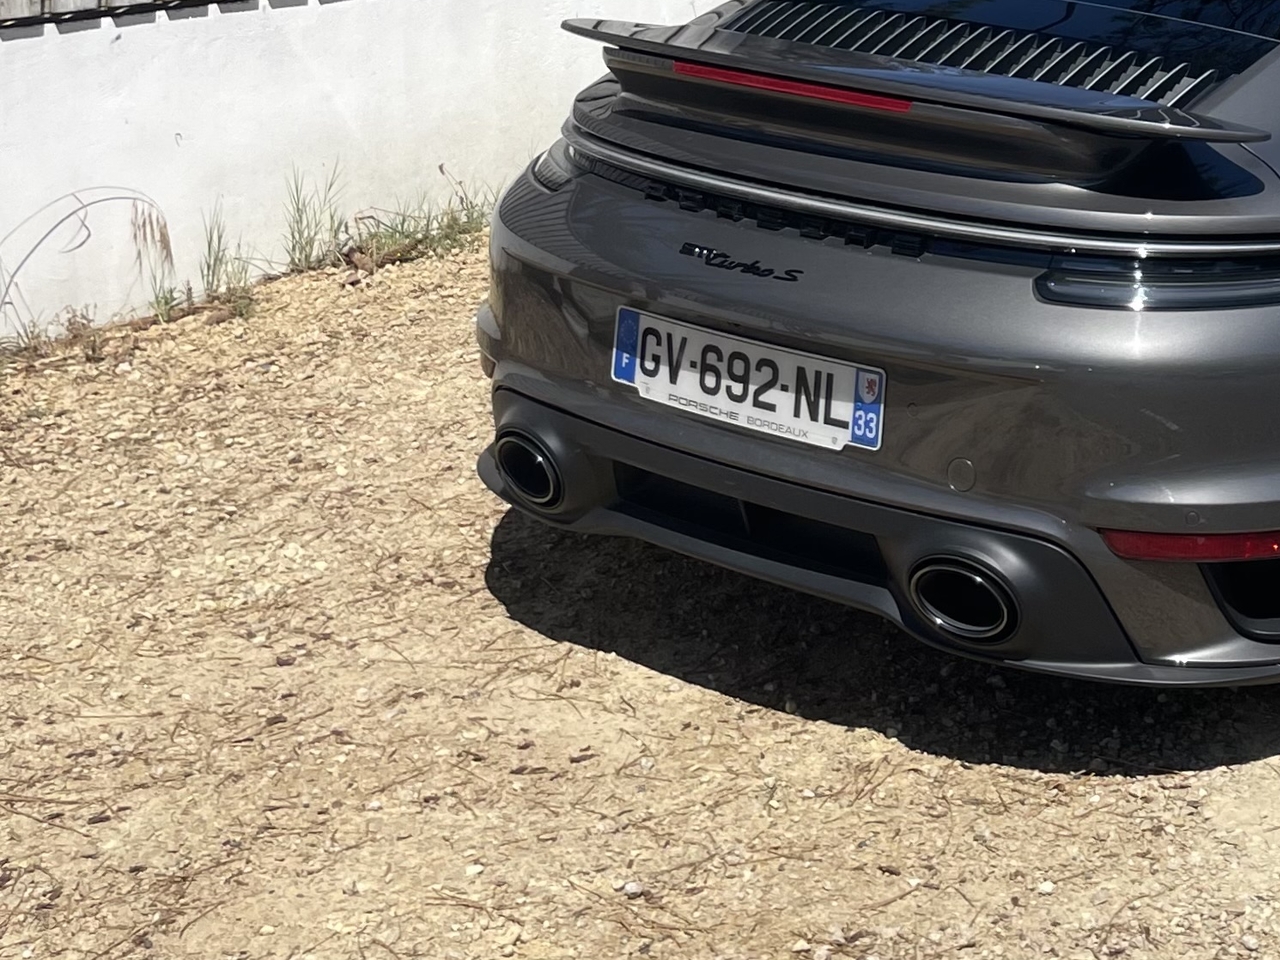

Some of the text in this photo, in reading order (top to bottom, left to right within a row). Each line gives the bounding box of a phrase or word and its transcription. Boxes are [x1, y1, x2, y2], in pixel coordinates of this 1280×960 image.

[705, 252, 775, 277] Turbo
[773, 269, 804, 282] S
[621, 352, 631, 368] F
[640, 326, 850, 430] GV-692-NL
[668, 393, 809, 439] PORSCHE BORDEAUX
[854, 410, 878, 439] 33
